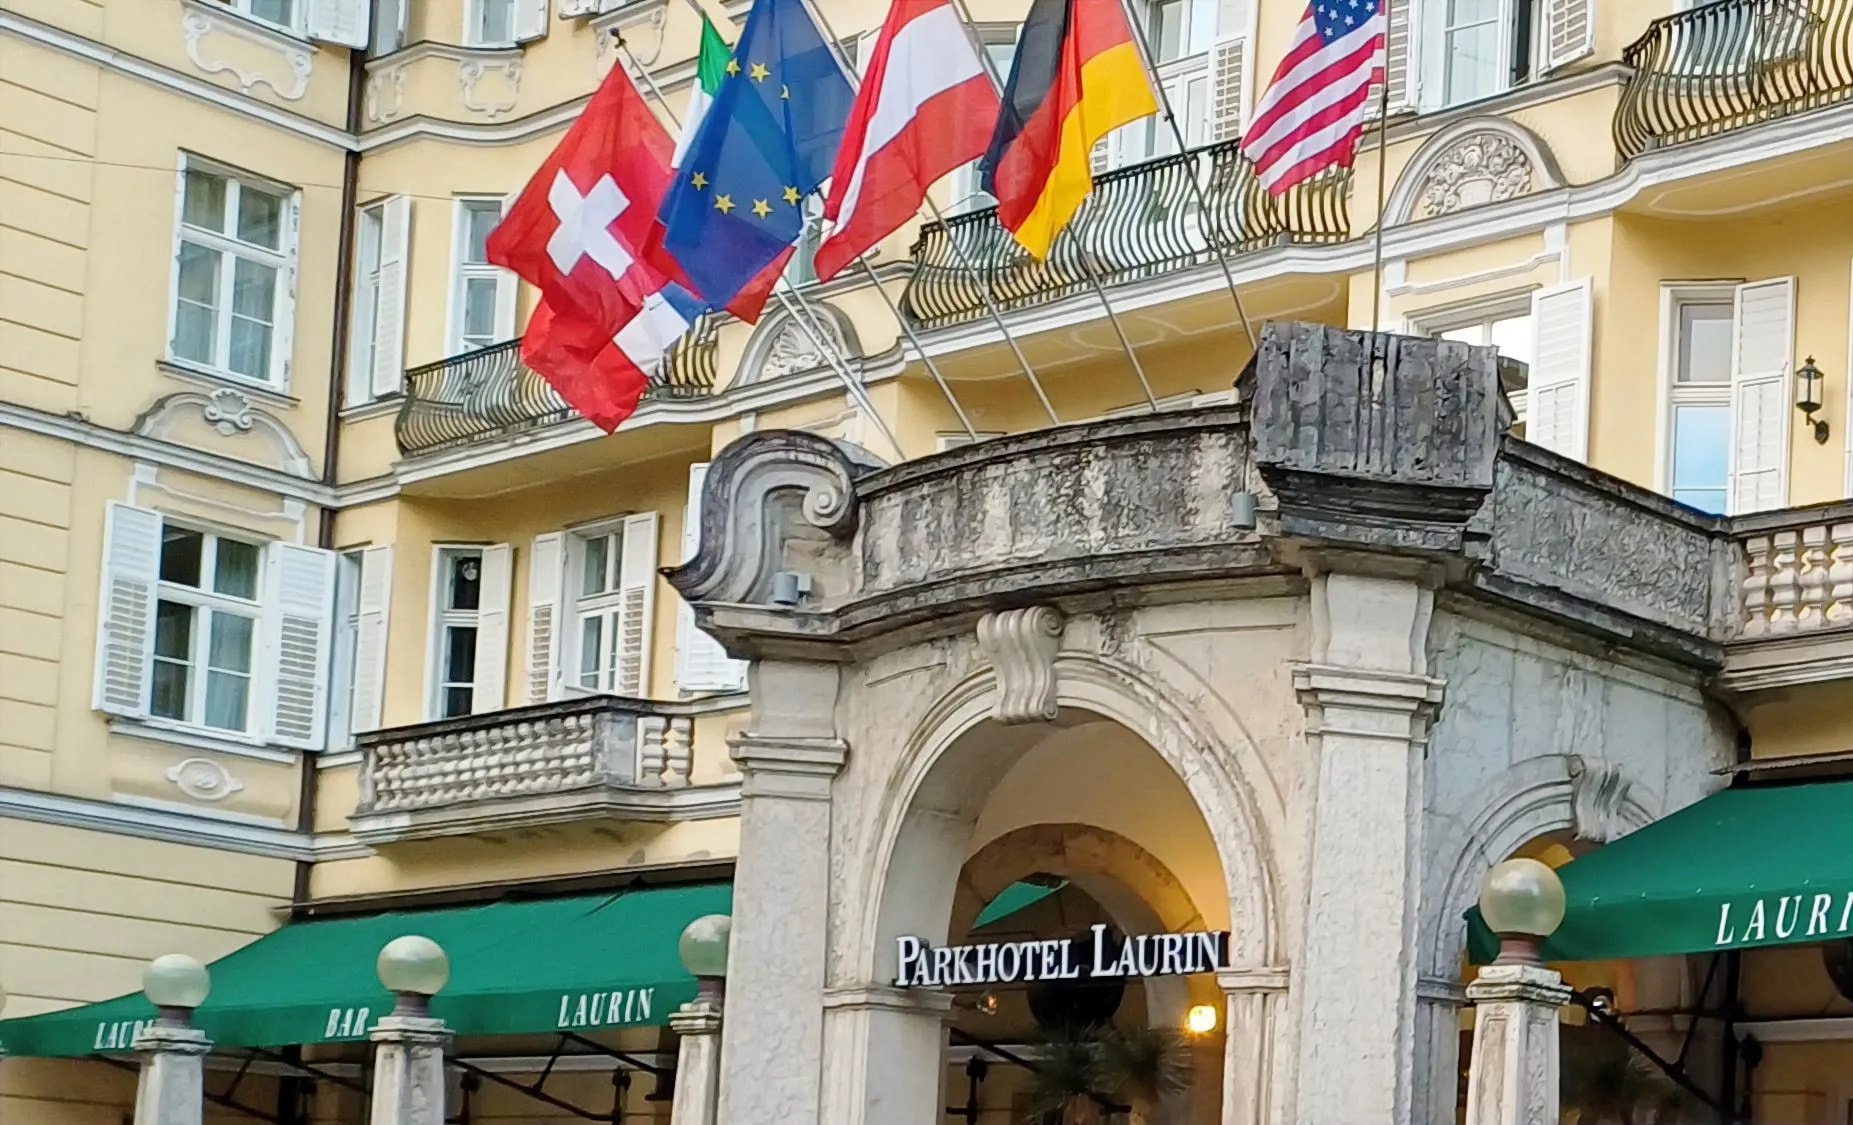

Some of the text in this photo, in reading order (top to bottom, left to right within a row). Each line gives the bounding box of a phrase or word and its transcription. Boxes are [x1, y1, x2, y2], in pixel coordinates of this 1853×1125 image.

[895, 924, 1222, 987] PARKHOTEL LAURIN
[325, 1007, 369, 1038] BAR
[557, 988, 655, 1027] LAURIN
